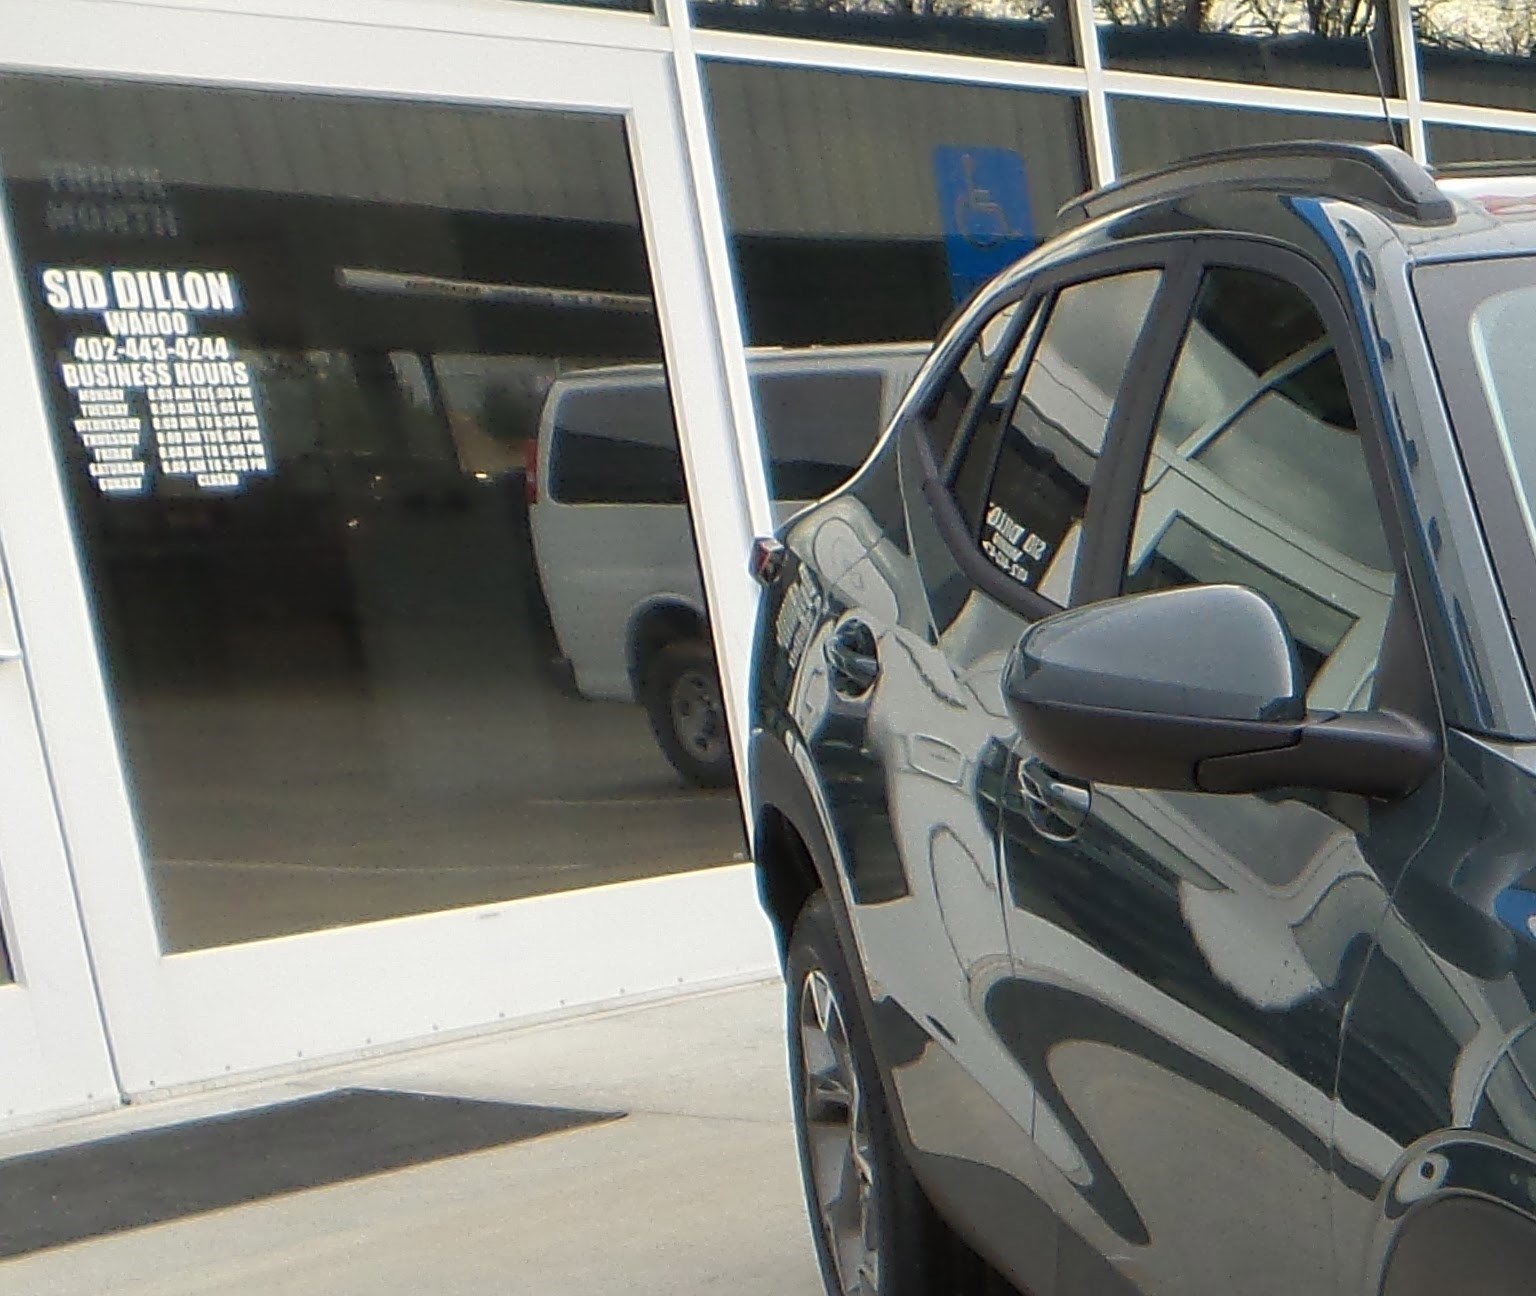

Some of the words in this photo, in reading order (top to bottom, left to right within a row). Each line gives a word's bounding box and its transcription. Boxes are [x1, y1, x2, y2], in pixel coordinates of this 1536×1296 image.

[43, 269, 108, 309] SID
[112, 271, 235, 311] DILLON
[104, 311, 189, 335] WAHOO
[74, 337, 230, 361] 402-443-4244
[62, 363, 172, 387] BUSINESS
[174, 362, 249, 386] HOURS
